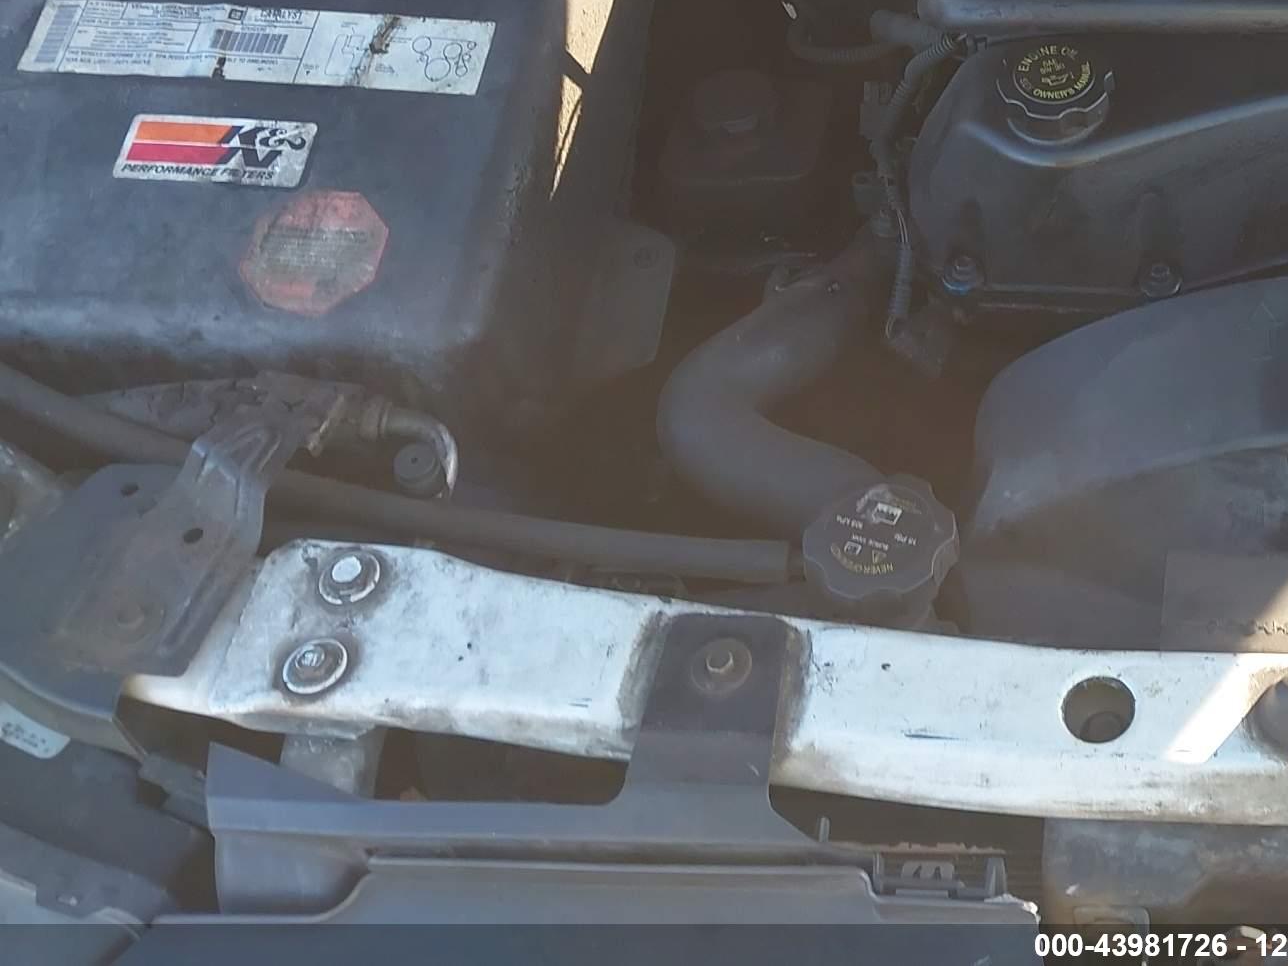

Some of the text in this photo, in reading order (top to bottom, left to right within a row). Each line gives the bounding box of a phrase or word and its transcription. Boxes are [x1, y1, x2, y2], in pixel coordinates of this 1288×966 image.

[1018, 45, 1057, 72] ENGINE
[1033, 88, 1075, 99] OWNER'S
[217, 125, 306, 170] K&N
[121, 163, 274, 180] PERFORMANCE FILTERS
